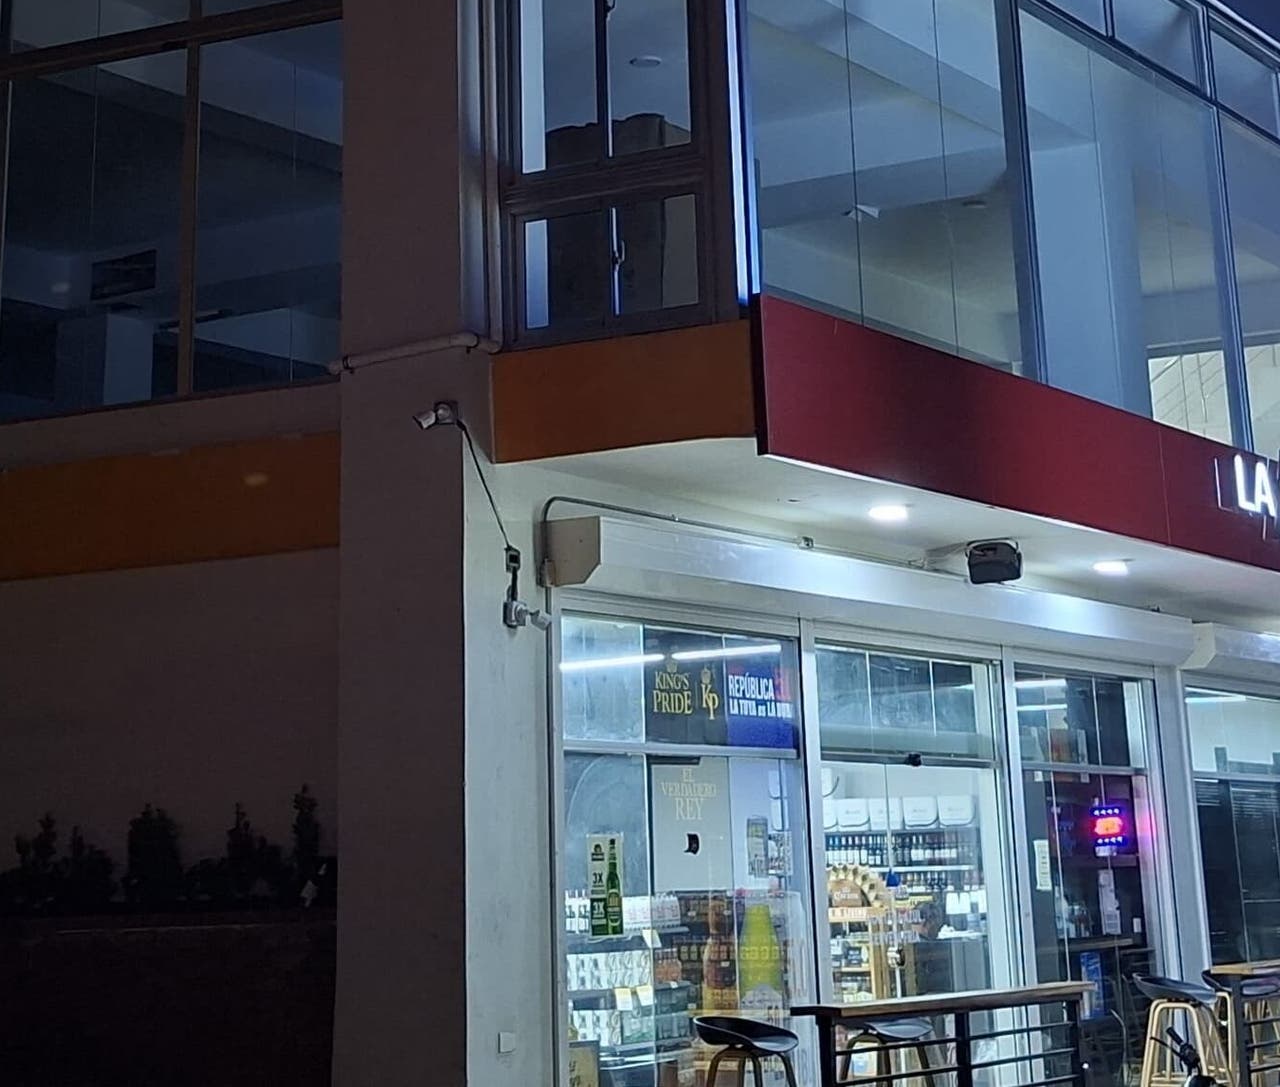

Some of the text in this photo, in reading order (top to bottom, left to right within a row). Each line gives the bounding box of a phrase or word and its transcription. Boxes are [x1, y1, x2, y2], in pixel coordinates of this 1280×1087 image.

[1233, 454, 1277, 518] LA
[655, 671, 690, 690] KING'S
[728, 672, 775, 700] REPÚBLICA
[653, 690, 693, 714] PRIDE
[674, 798, 705, 821] REY
